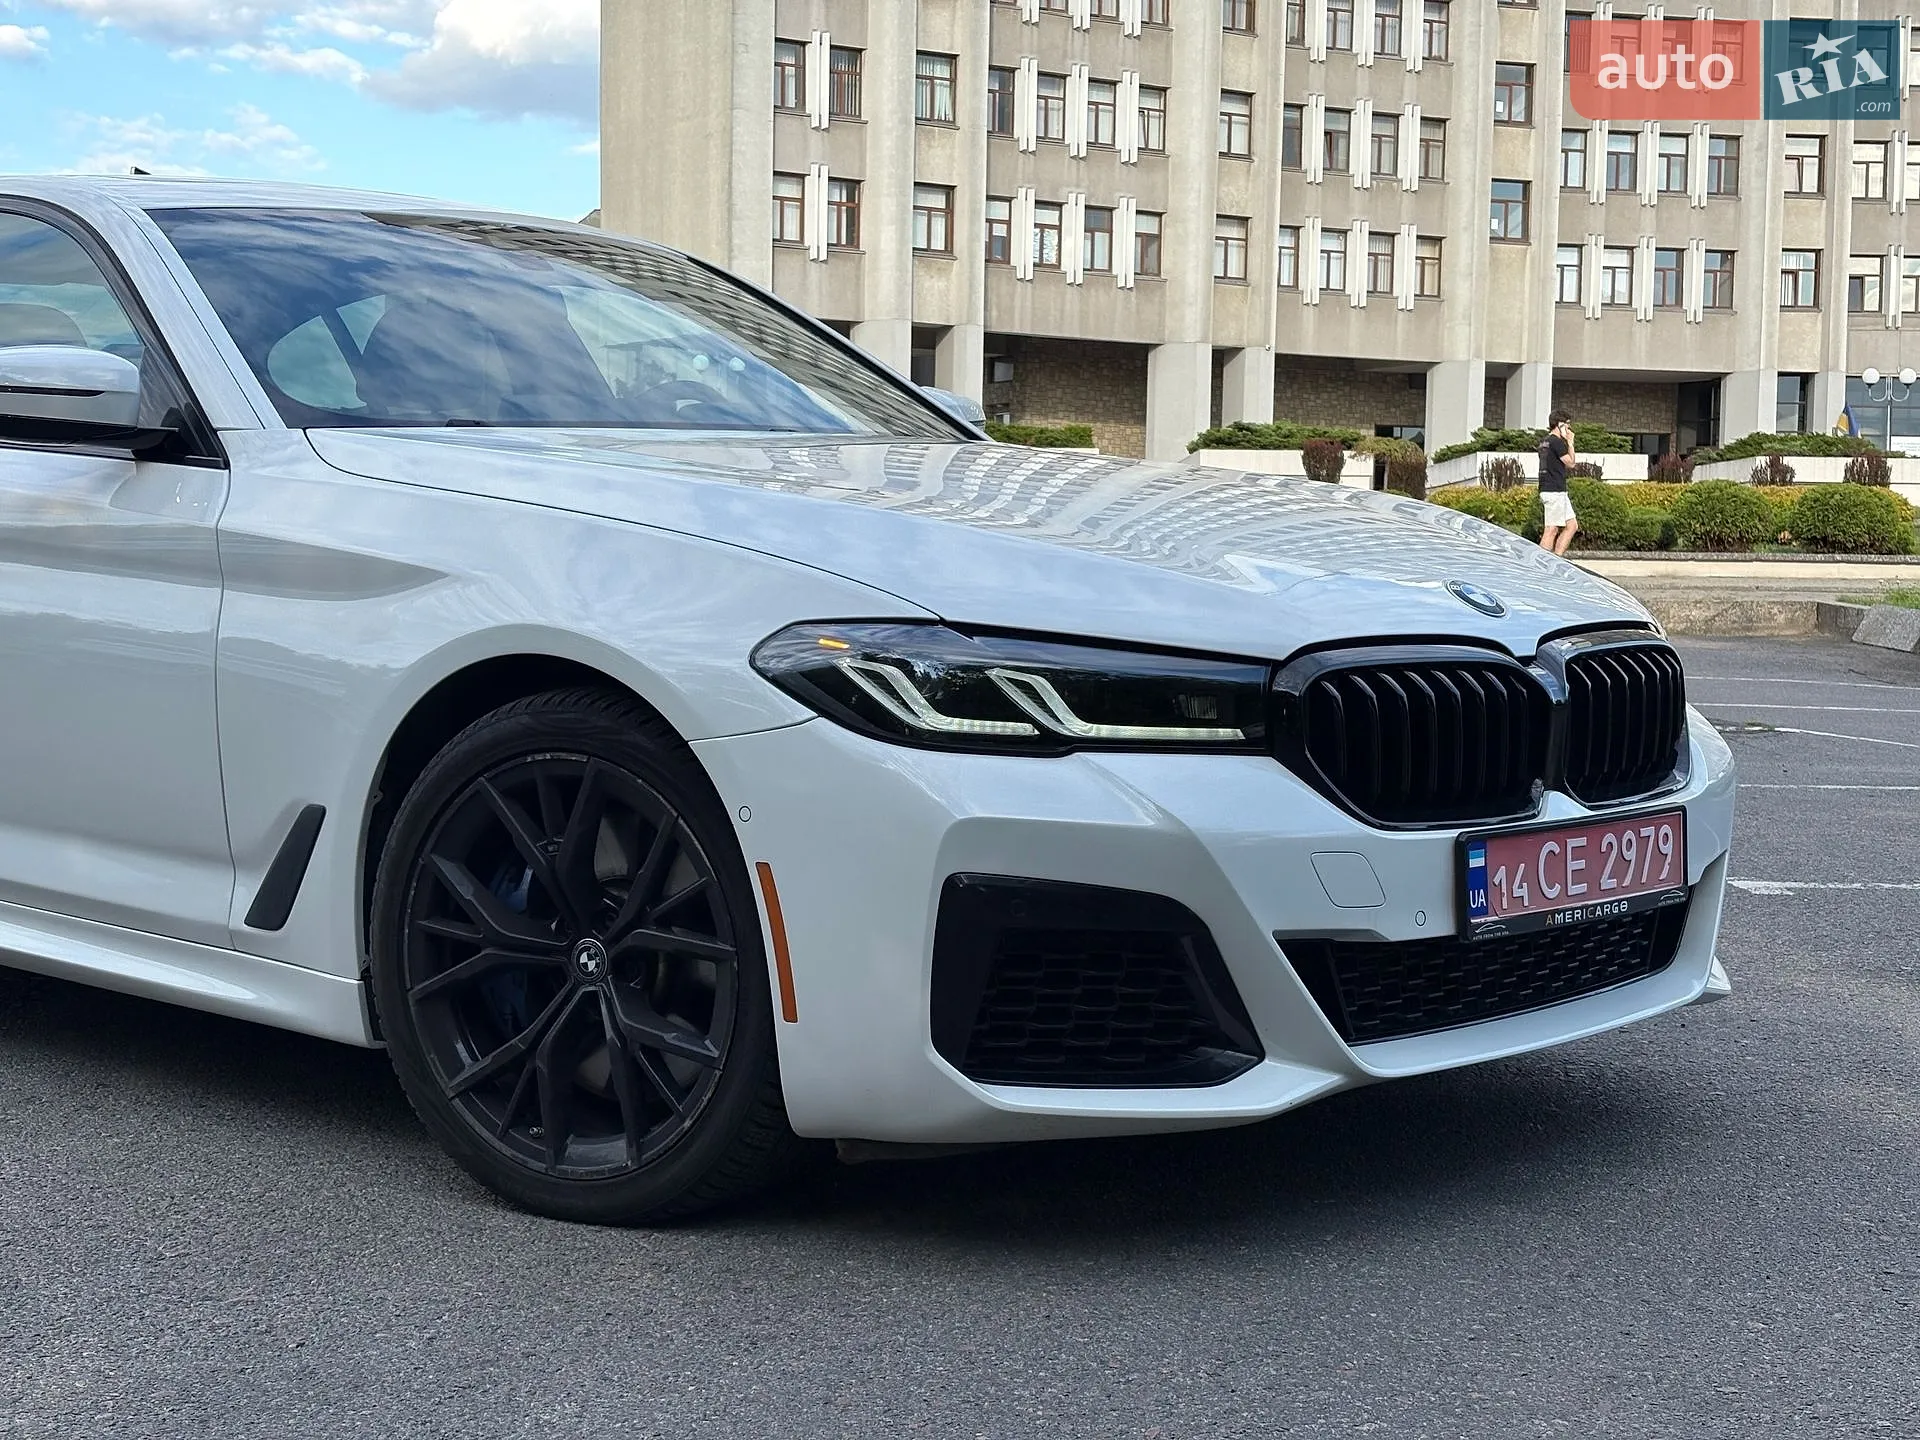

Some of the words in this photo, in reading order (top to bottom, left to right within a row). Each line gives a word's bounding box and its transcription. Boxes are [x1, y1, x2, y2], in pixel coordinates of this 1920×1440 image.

[1492, 863, 1530, 910] 14
[1538, 836, 1588, 900] CE
[1599, 824, 1673, 891] 2979
[1469, 889, 1487, 908] UA
[1545, 900, 1628, 926] AMERICARGO
